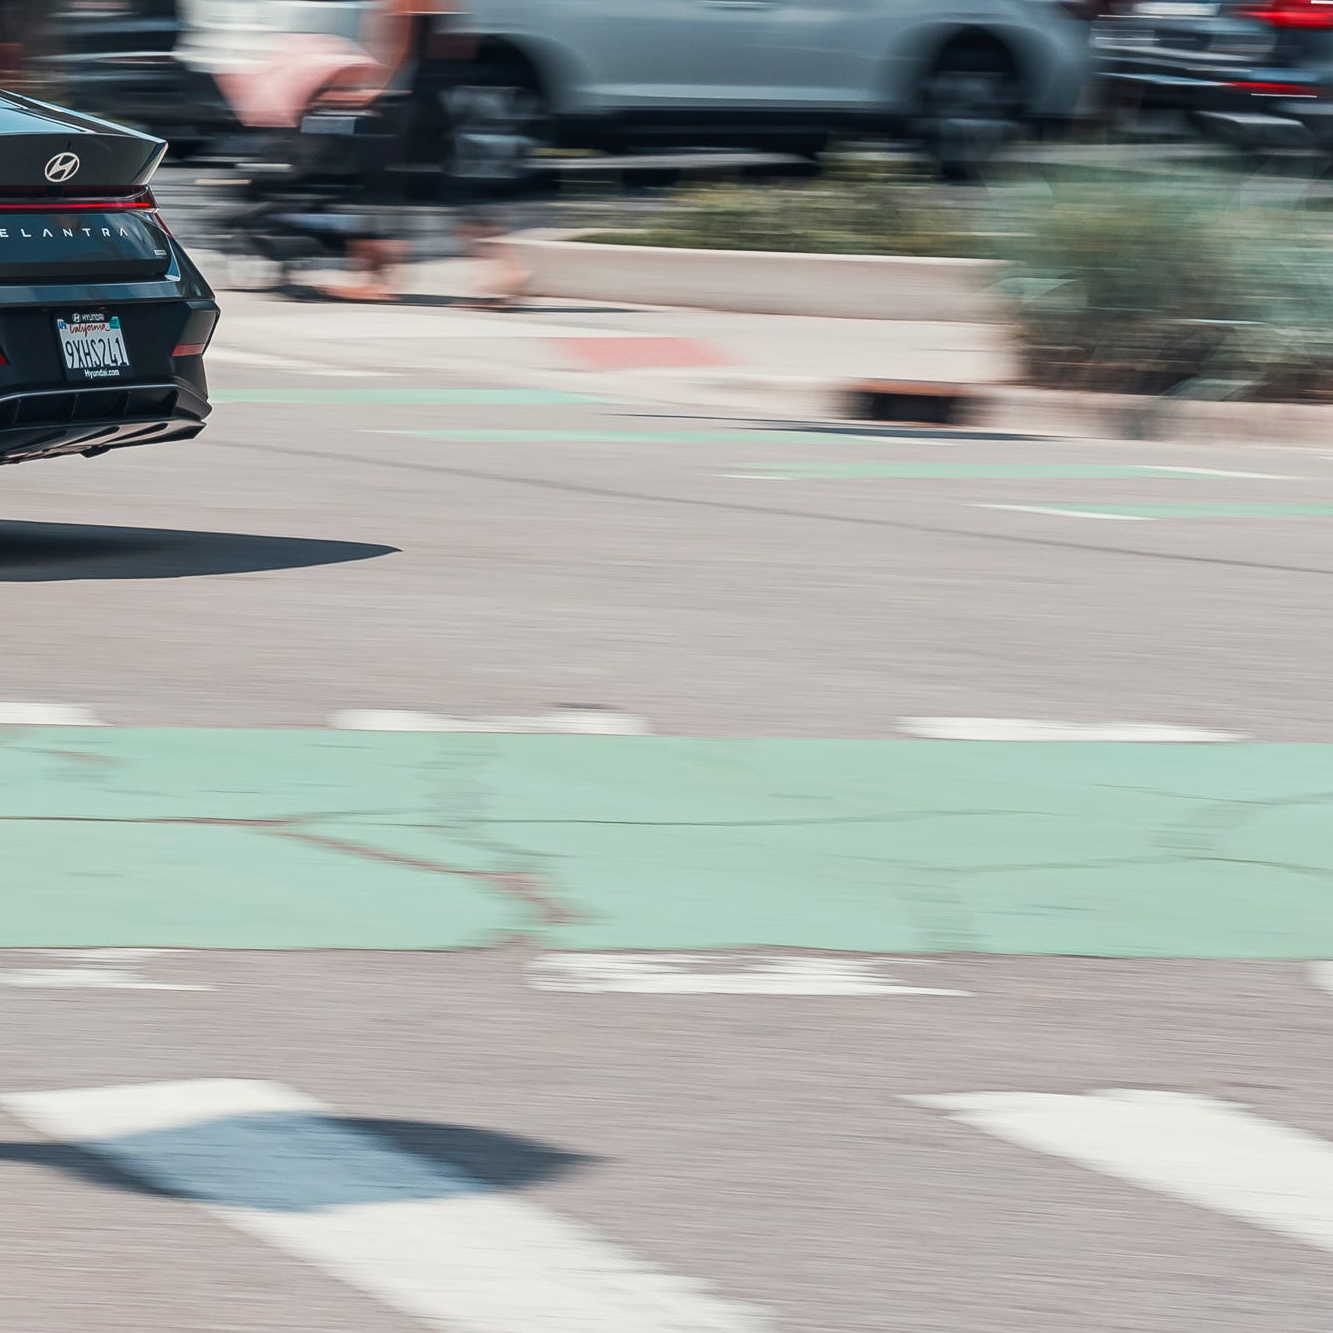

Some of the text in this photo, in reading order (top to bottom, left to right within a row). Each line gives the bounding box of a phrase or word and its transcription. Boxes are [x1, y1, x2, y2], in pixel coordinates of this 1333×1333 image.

[81, 313, 105, 322] HYUNDAI
[69, 323, 111, 338] California
[65, 337, 128, 368] 9XHS241
[84, 369, 120, 379] Hyundai.com
